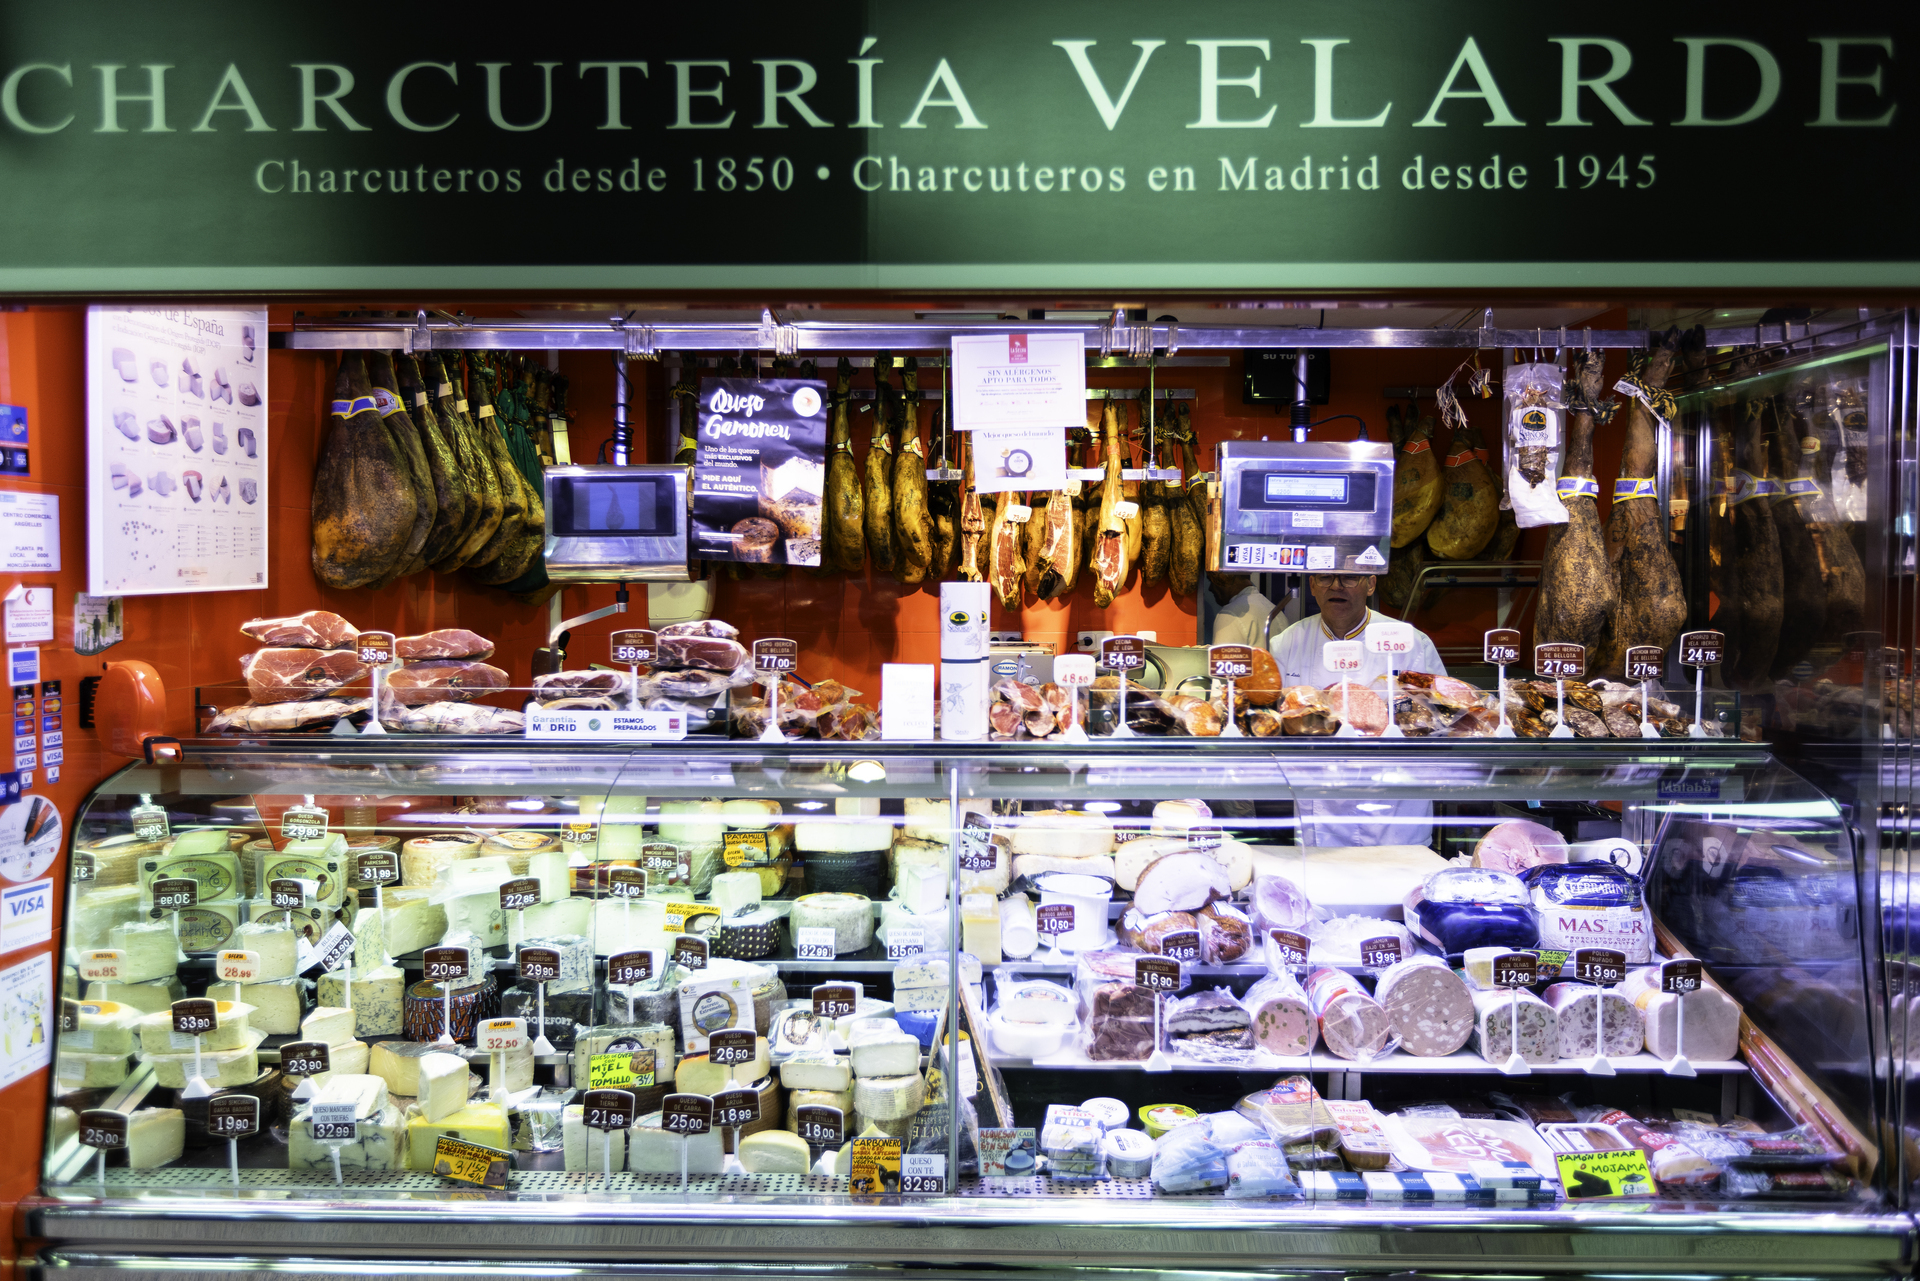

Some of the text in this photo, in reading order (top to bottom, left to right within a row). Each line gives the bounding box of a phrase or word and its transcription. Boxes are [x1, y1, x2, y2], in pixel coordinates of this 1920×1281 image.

[0, 36, 1898, 135] CHARCUTERÍA VELARDE
[254, 154, 1658, 195] Charcuteros desde 1850 Charcuteros en Madrid desde 1945
[183, 311, 225, 336] España
[1003, 367, 1052, 375] ALÉRGENOS
[710, 387, 766, 416] Queso
[728, 446, 737, 454] los
[738, 448, 760, 456] quesos
[704, 452, 752, 462] más EXCLUSIVOS
[713, 483, 758, 493] AUTÉNTICO.
[18, 740, 35, 748] VISA
[46, 735, 62, 744] VISA
[47, 752, 62, 761] VISA
[19, 757, 36, 766] VISA
[516, 884, 534, 892] TOLEDO
[10, 896, 45, 917] VISA
[321, 933, 334, 947] BLUE
[323, 933, 342, 954] STILTON
[623, 957, 648, 966] CABRALES
[700, 1001, 718, 1010] Secreto
[853, 1139, 901, 1148] CARBONERO
[1612, 1150, 1636, 1159] MAR
[909, 1157, 932, 1166] QUESO
[908, 1165, 934, 1174] CON TÉ
[1591, 1163, 1647, 1174] MOJAMA
